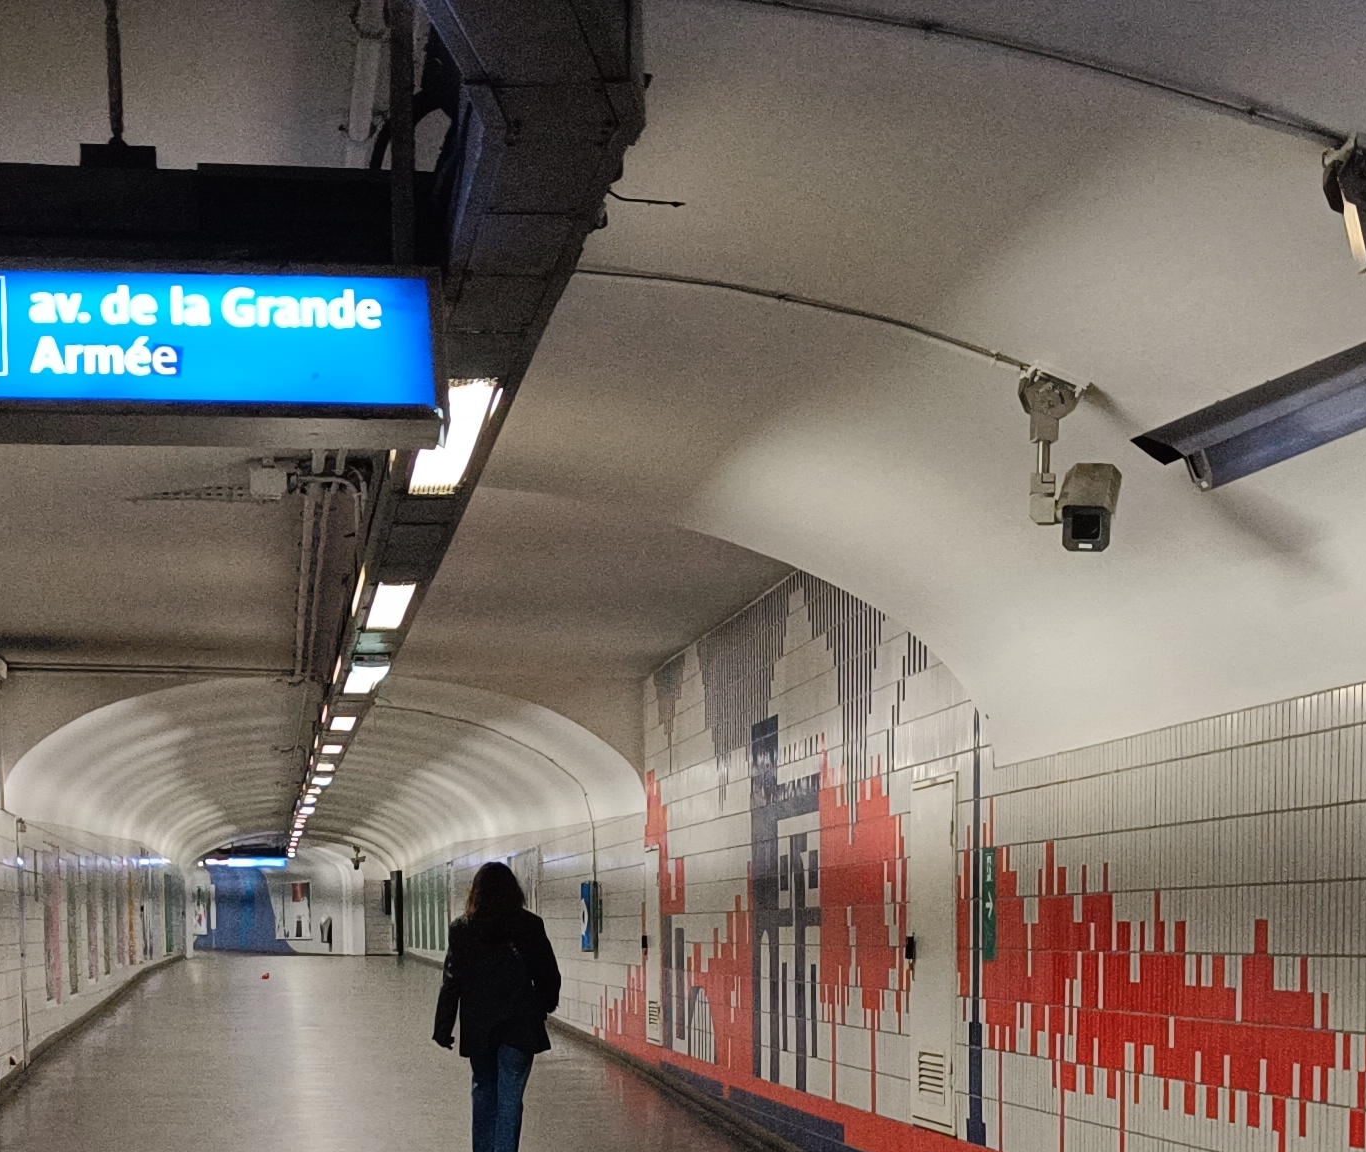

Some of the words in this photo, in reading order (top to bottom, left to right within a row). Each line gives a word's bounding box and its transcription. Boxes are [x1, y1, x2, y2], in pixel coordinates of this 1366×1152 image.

[29, 291, 91, 324] av.
[100, 284, 158, 325] de
[170, 285, 211, 327] la
[221, 286, 382, 329] Grande
[30, 335, 178, 376] Armée
